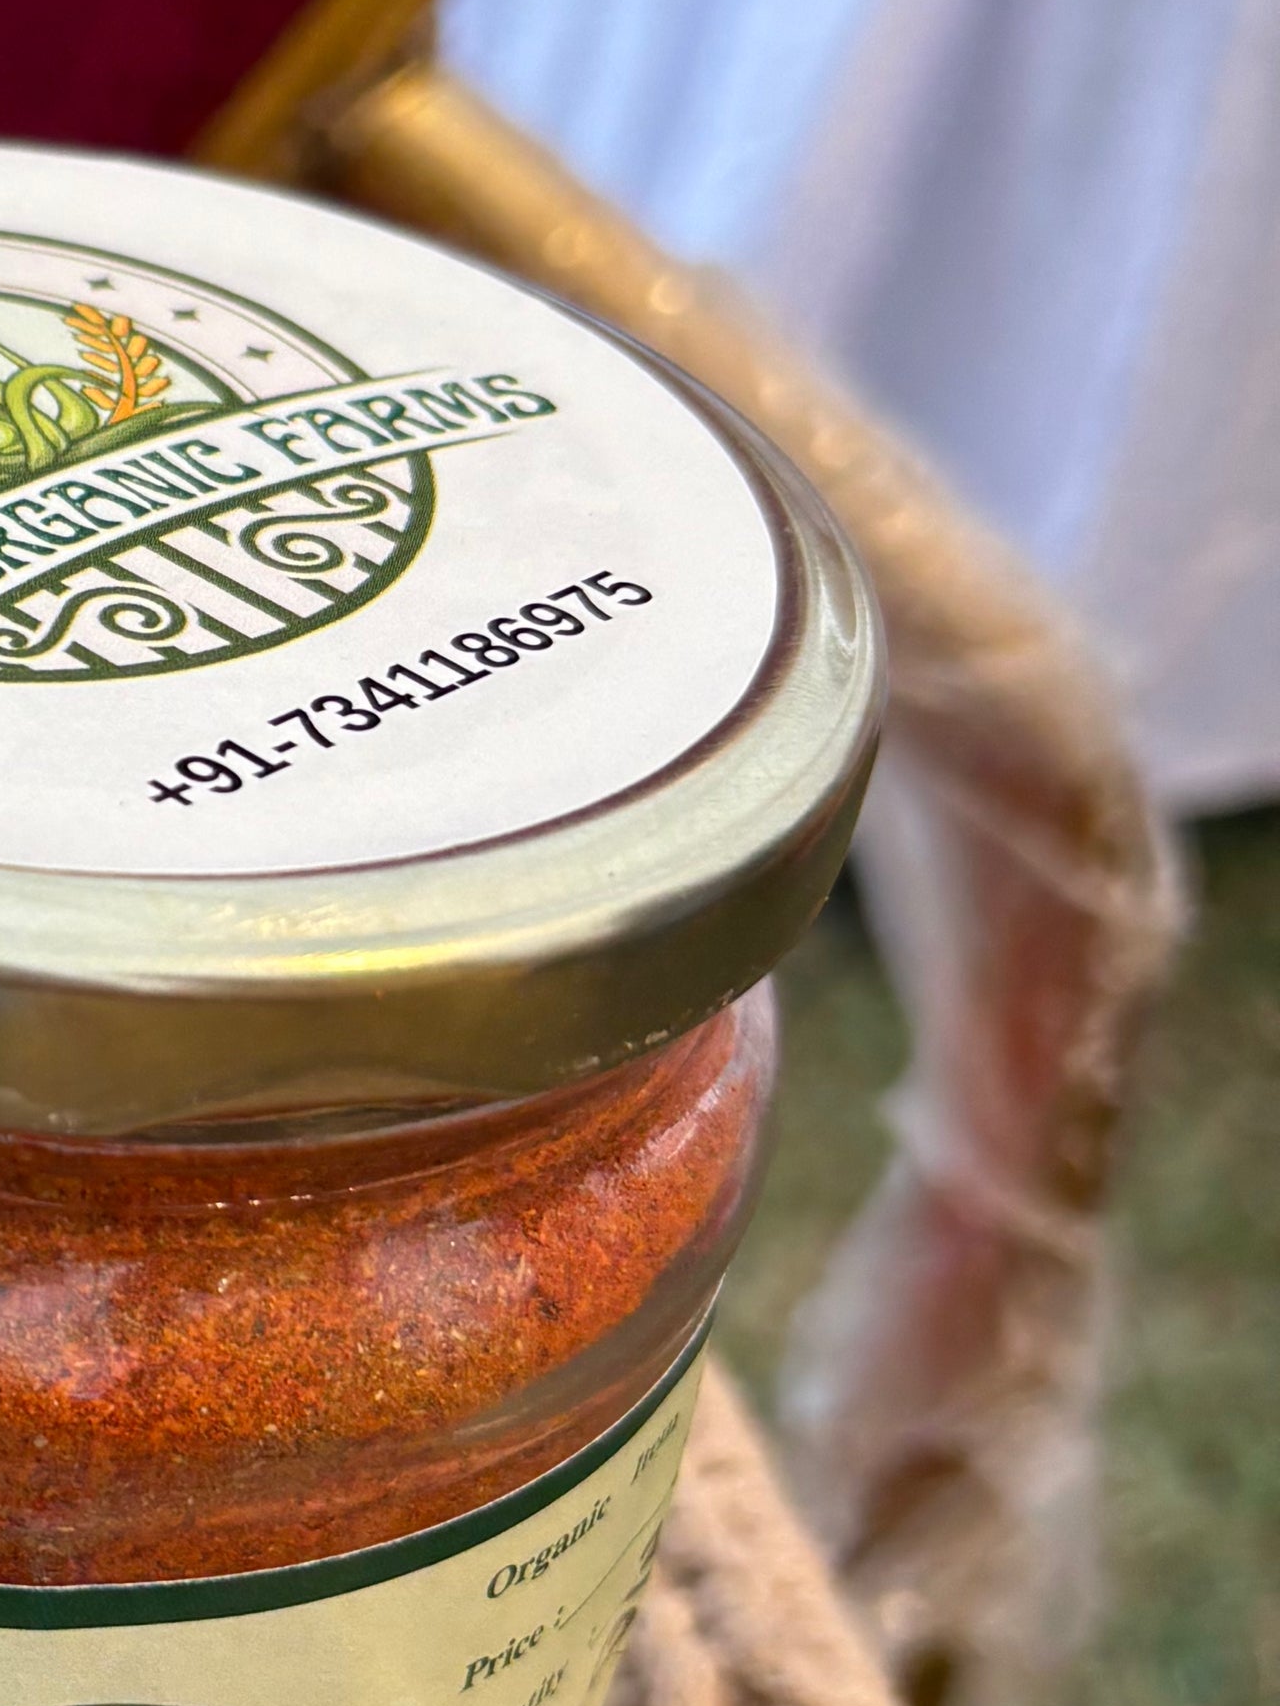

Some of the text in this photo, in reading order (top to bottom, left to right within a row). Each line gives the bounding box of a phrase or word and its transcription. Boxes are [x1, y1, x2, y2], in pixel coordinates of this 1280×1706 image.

[260, 371, 559, 469] FARMS
[147, 568, 652, 809] +91-7341186975
[487, 1494, 611, 1599] Organic
[459, 1624, 544, 1694] Price
